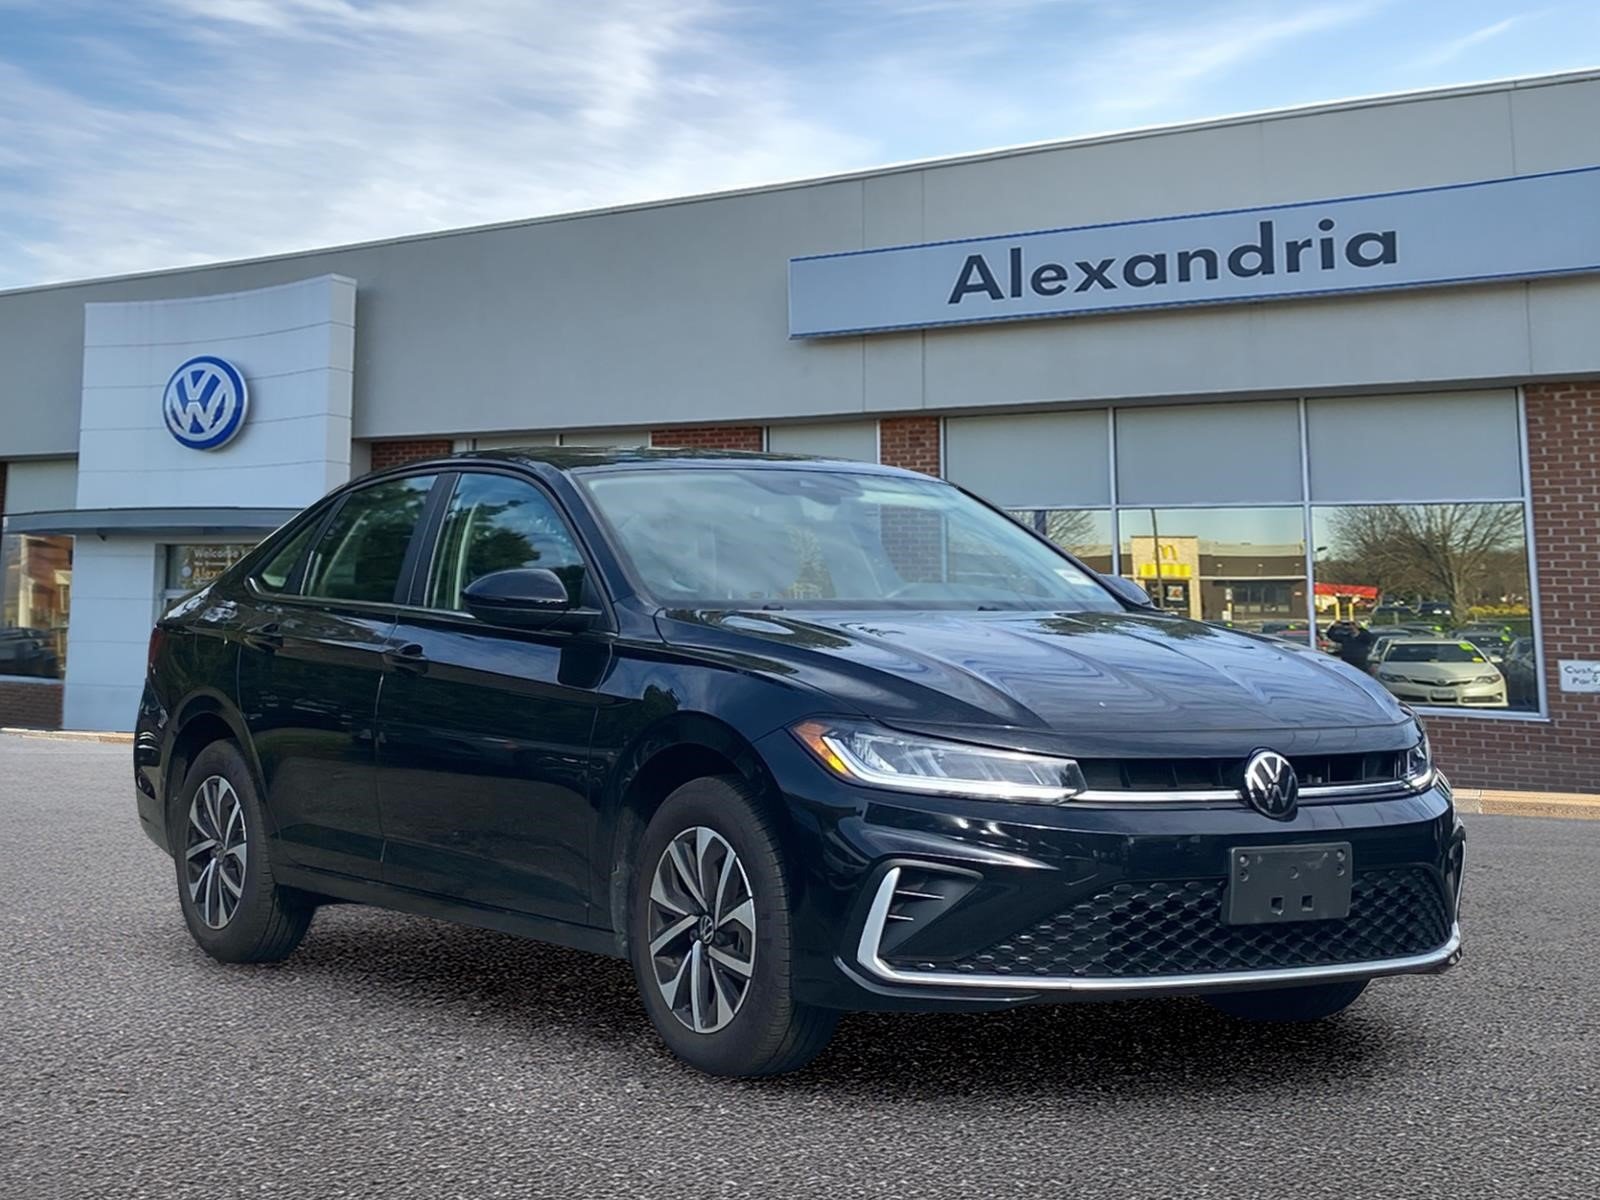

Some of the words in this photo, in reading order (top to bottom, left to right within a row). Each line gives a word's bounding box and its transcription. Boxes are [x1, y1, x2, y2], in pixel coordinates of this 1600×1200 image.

[947, 216, 1398, 304] Alexandria
[167, 364, 237, 440] VW
[1564, 665, 1599, 675] Cust
